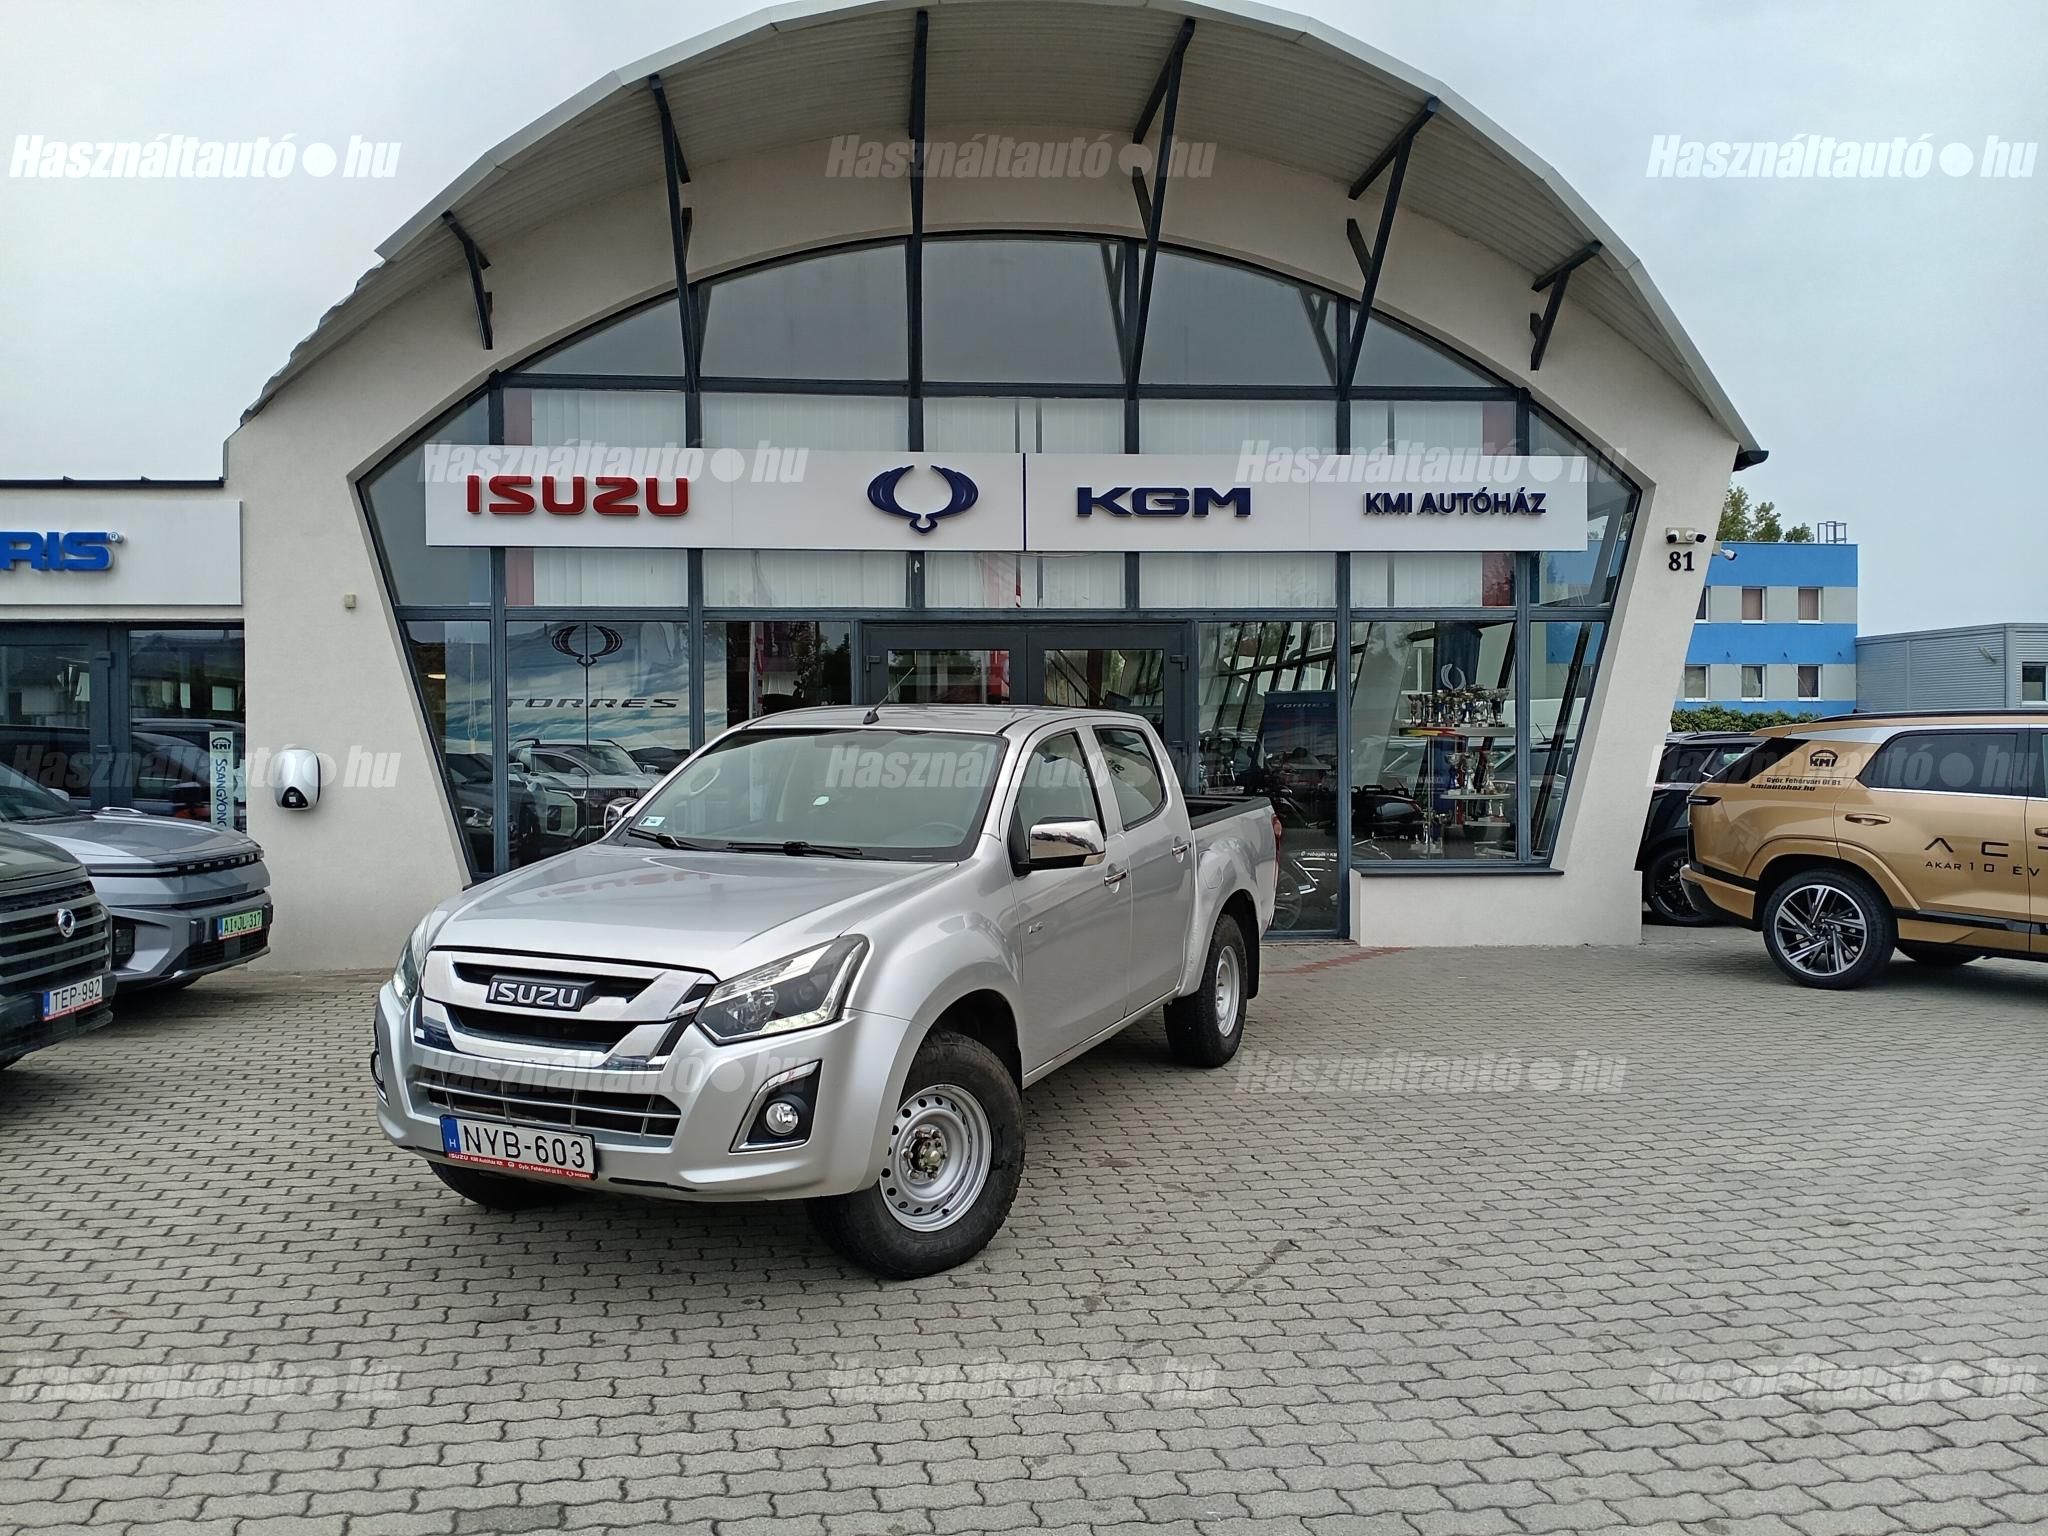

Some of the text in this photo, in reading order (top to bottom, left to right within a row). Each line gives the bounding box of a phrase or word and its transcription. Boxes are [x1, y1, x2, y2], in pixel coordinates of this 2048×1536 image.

[466, 474, 689, 516] ISUZU
[1076, 487, 1251, 516] KGM
[1364, 486, 1547, 514] KMI AUTÓHÁZ
[1668, 551, 1695, 572] 81
[1810, 758, 1835, 767] KMI
[53, 979, 100, 1011] TEP-992
[489, 982, 579, 1008] ISUZU
[449, 1139, 456, 1148] H
[463, 1125, 586, 1168] NYB-603
